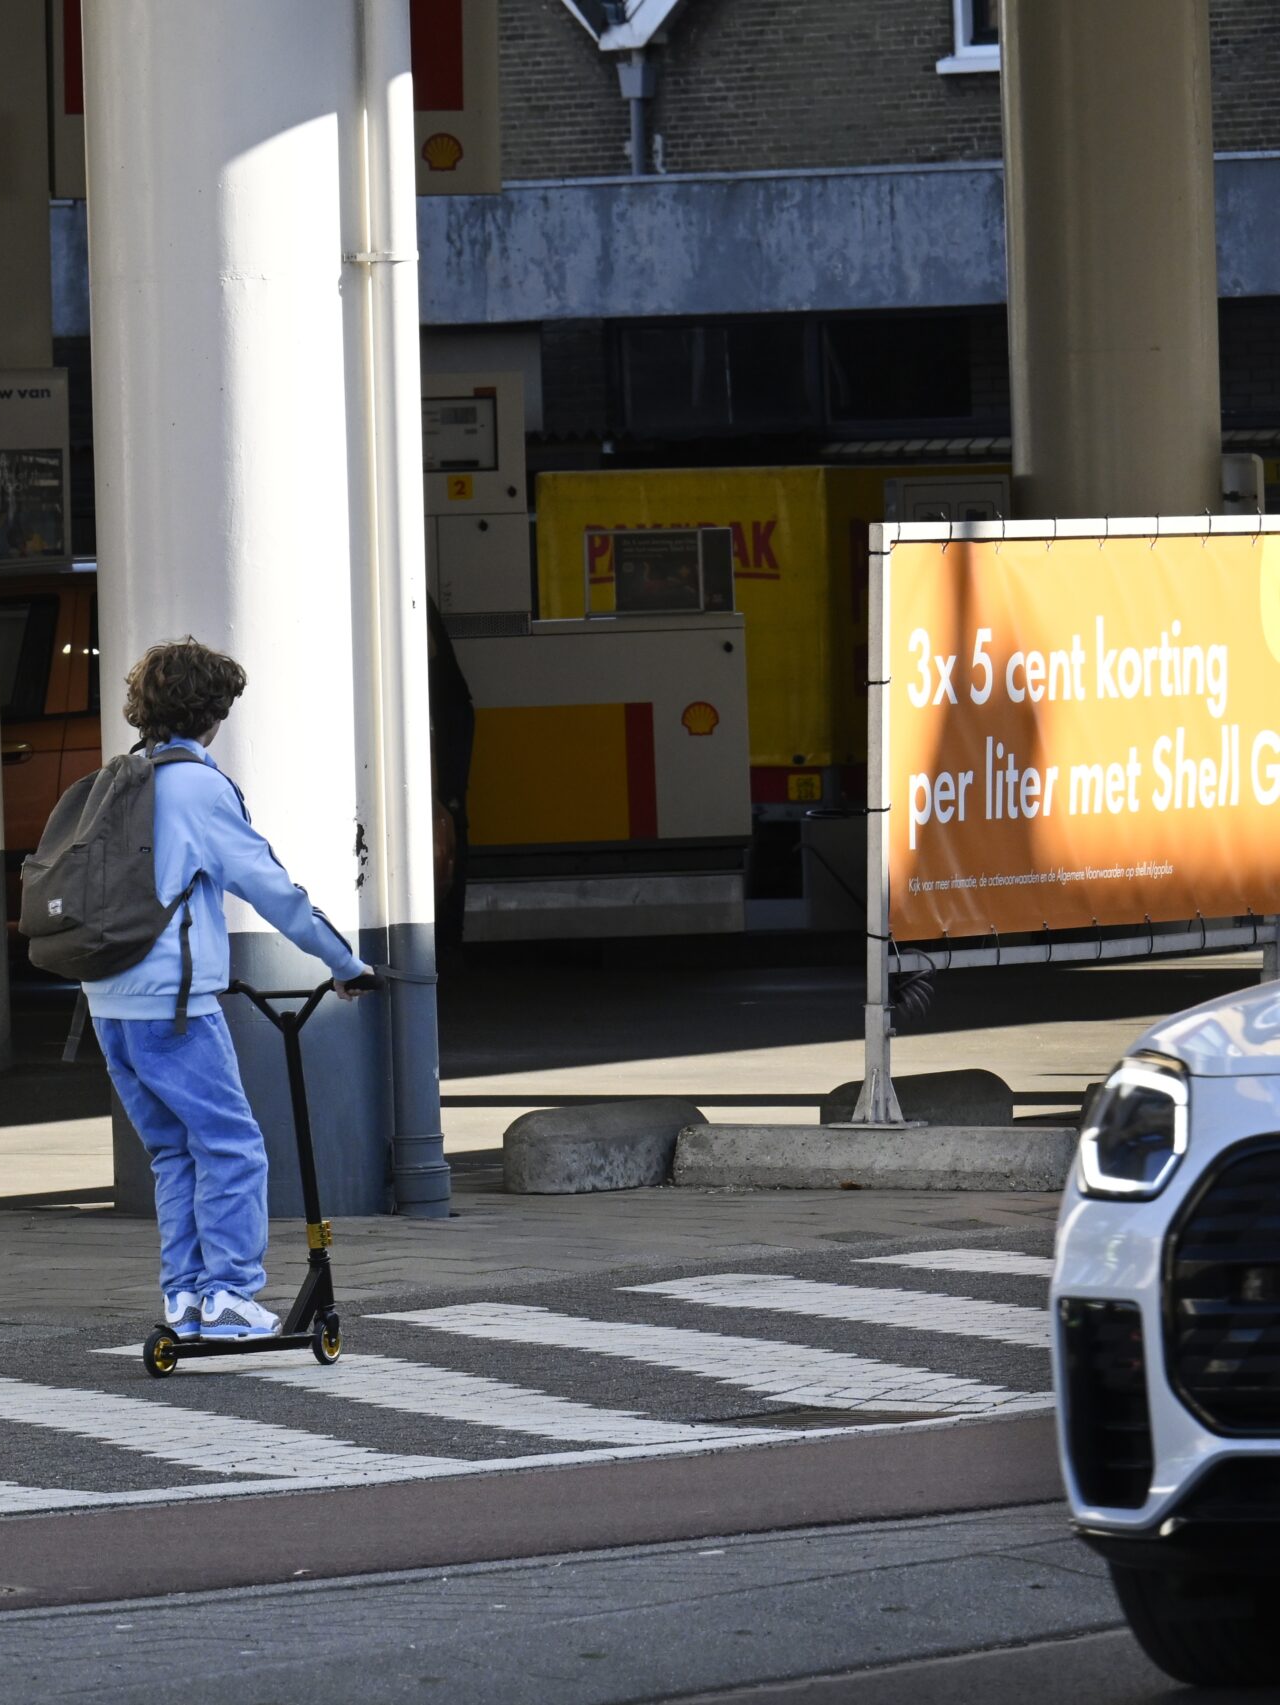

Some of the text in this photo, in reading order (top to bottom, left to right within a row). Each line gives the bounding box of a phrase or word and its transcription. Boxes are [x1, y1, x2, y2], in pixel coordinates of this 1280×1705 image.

[17, 388, 51, 399] van
[454, 480, 466, 496] 2
[906, 615, 1228, 719] 3x 5 cent korting
[908, 769, 974, 850] per
[984, 735, 1060, 820] liter
[1068, 746, 1142, 816] met
[1151, 723, 1240, 812] Shell
[908, 876, 921, 896] Kijk
[979, 872, 987, 887] de
[1085, 863, 1124, 880] Voorwaarden
[1125, 868, 1134, 881] op
